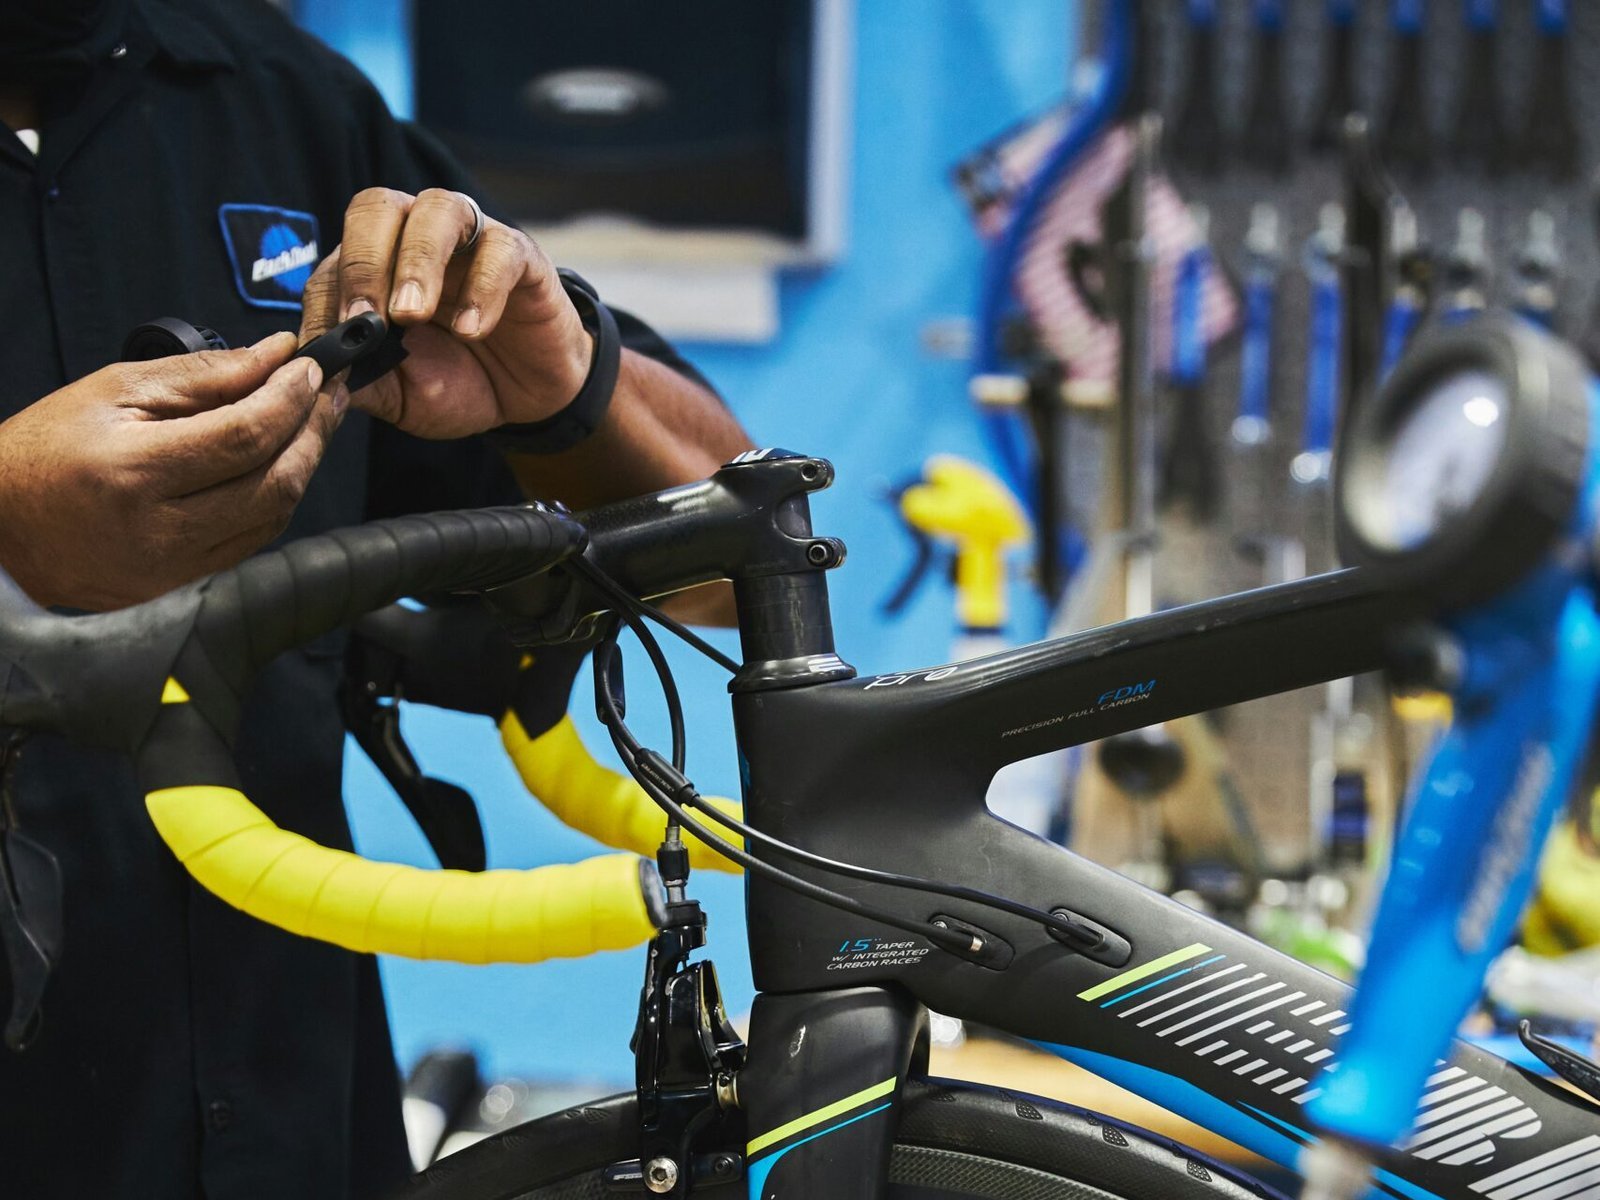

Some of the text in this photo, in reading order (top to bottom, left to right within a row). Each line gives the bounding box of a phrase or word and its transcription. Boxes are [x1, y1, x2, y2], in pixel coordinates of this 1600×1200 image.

[863, 666, 958, 690] pro
[1097, 679, 1157, 705] FDM
[1001, 692, 1151, 739] PRECISION FULL CARBON
[852, 948, 929, 961] INTEGRATED
[875, 941, 915, 951] TAPER
[826, 956, 922, 971] CARBON RACES
